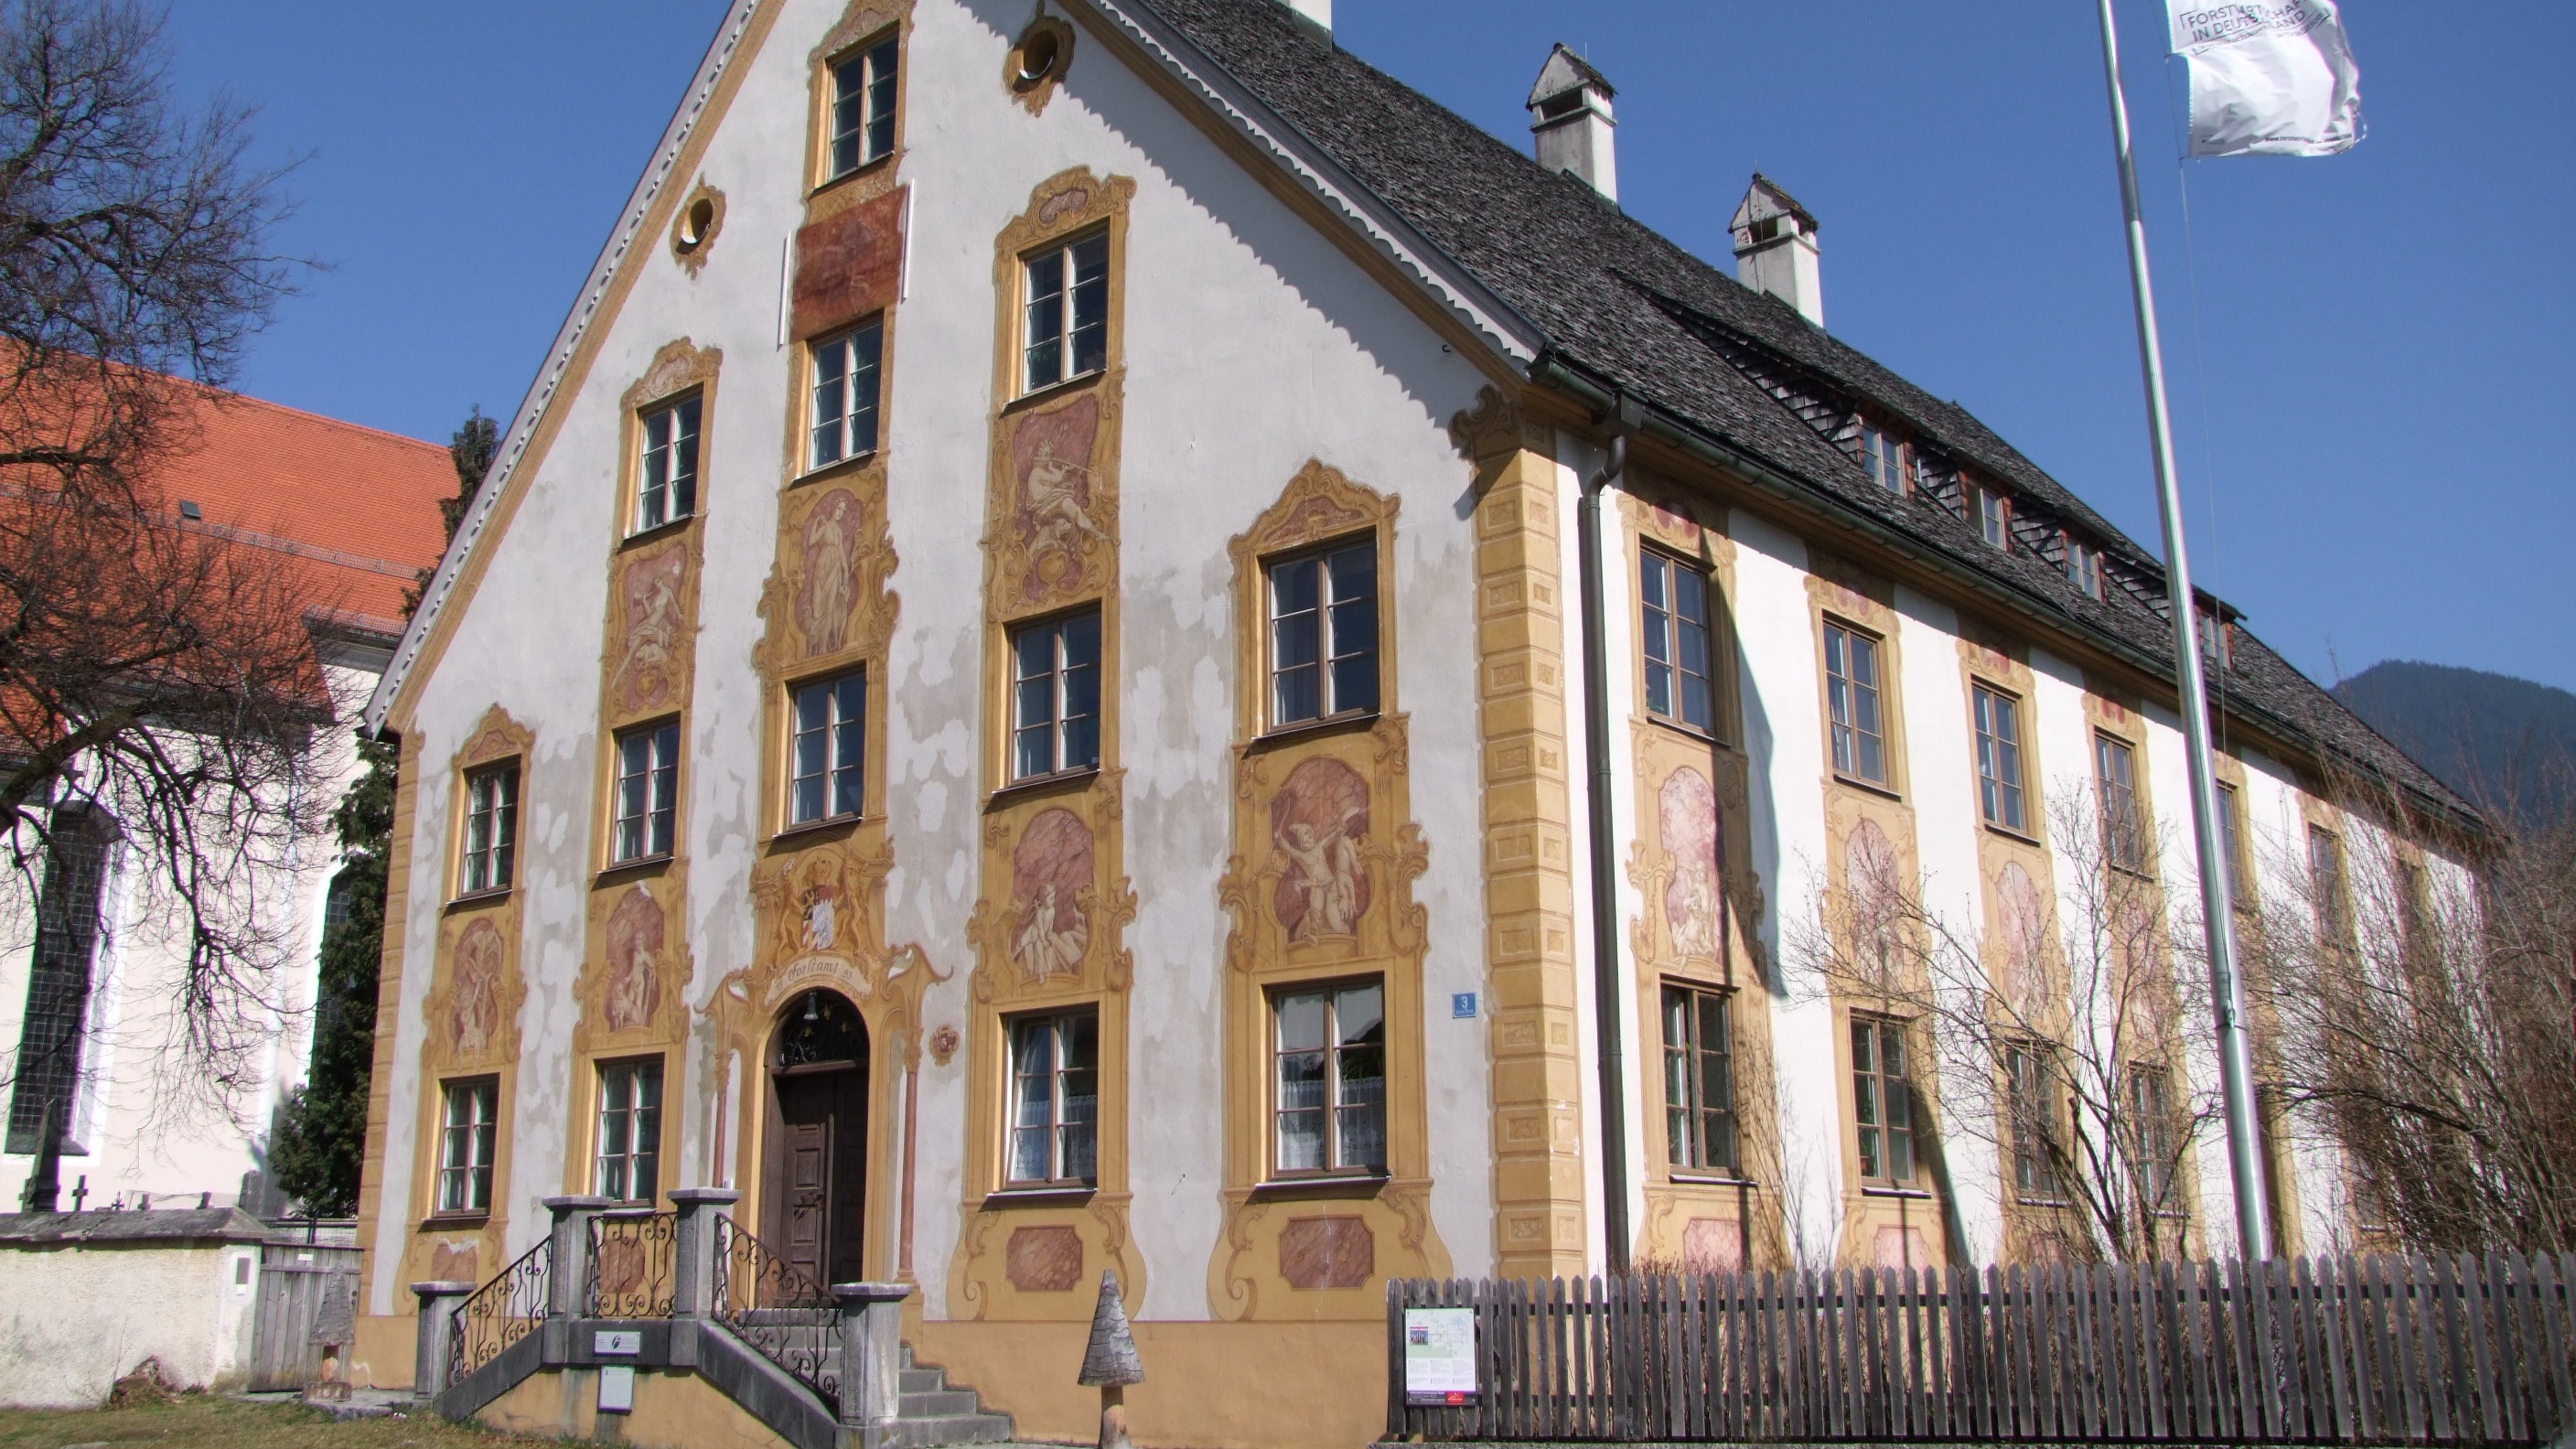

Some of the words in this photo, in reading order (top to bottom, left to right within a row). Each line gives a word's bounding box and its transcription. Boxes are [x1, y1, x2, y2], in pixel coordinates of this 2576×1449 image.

[2193, 27, 2209, 42] IN
[2213, 10, 2305, 35] DEUTSLAND
[1461, 995, 1468, 1008] 3
